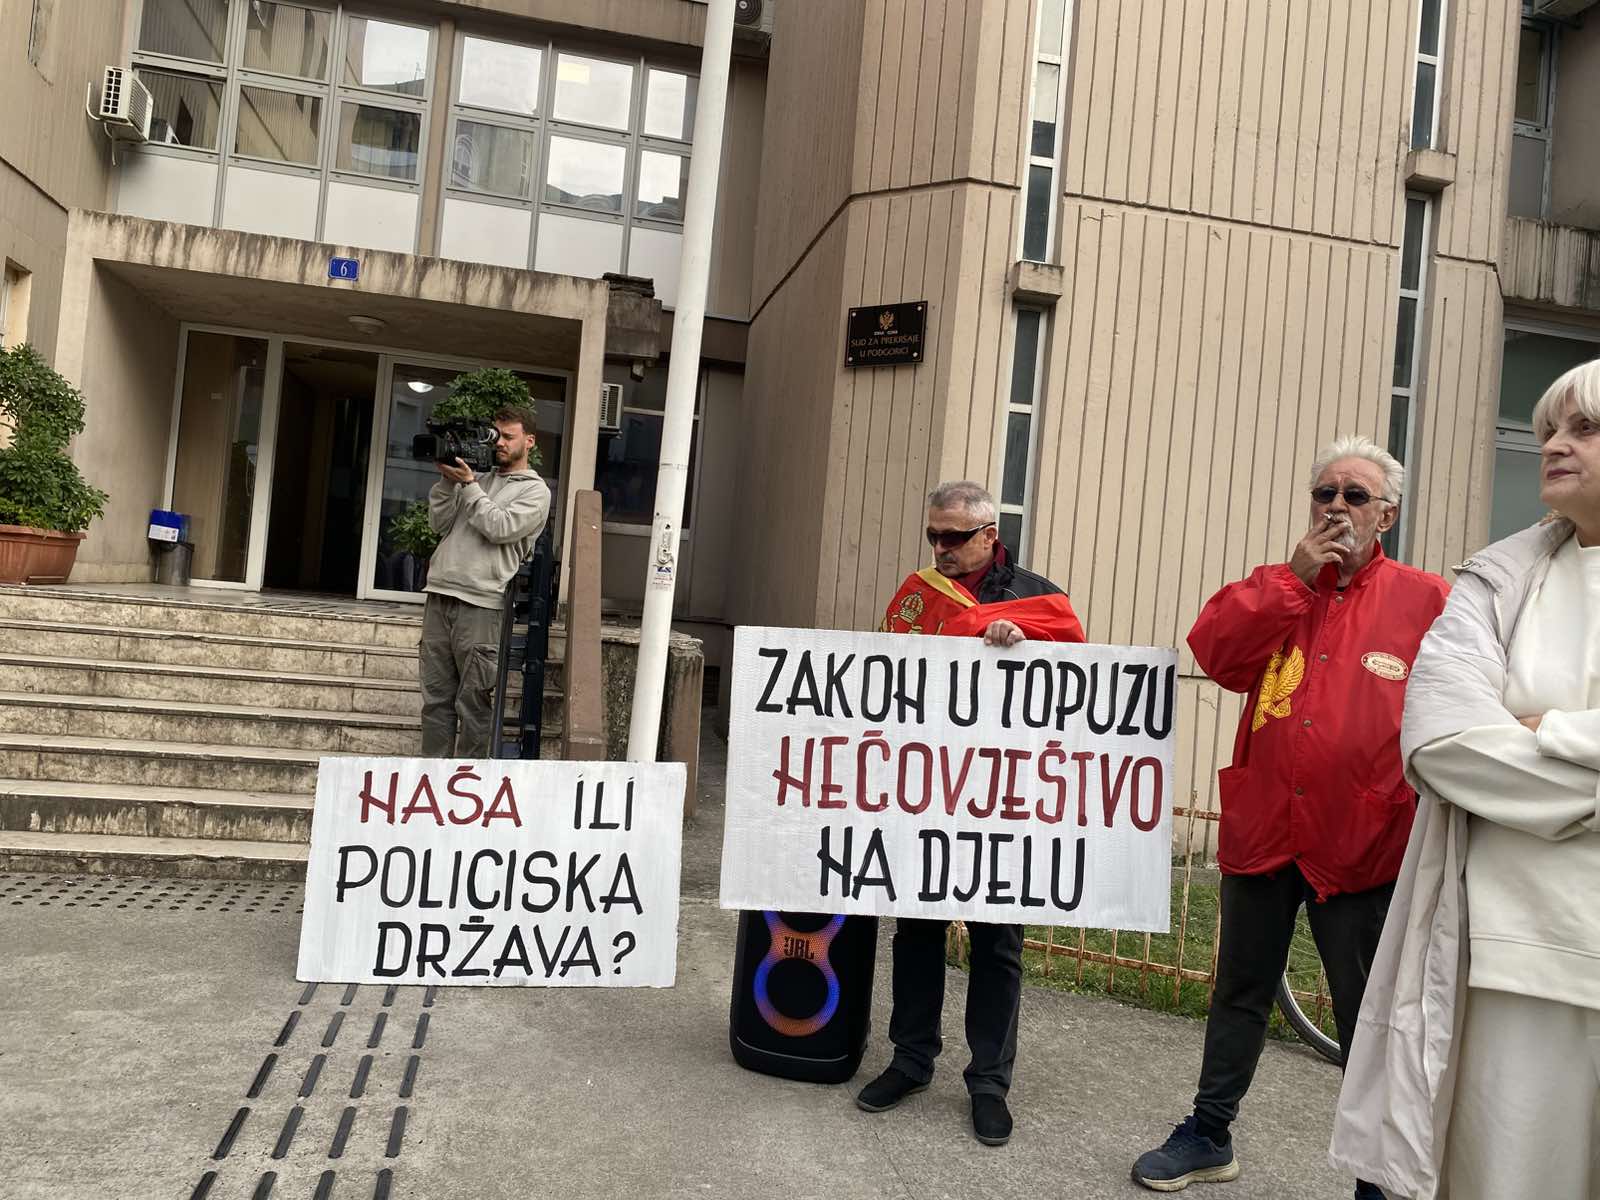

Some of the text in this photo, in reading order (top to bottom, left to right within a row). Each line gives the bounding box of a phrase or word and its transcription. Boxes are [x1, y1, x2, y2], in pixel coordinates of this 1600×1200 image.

[340, 261, 348, 277] 6
[948, 659, 980, 727] U
[996, 658, 1176, 740] TOPUZU
[336, 844, 644, 916] POLICISKA
[917, 828, 1086, 912] DJELU
[372, 915, 637, 978] DRŽAVA?
[784, 936, 815, 960] JBL
